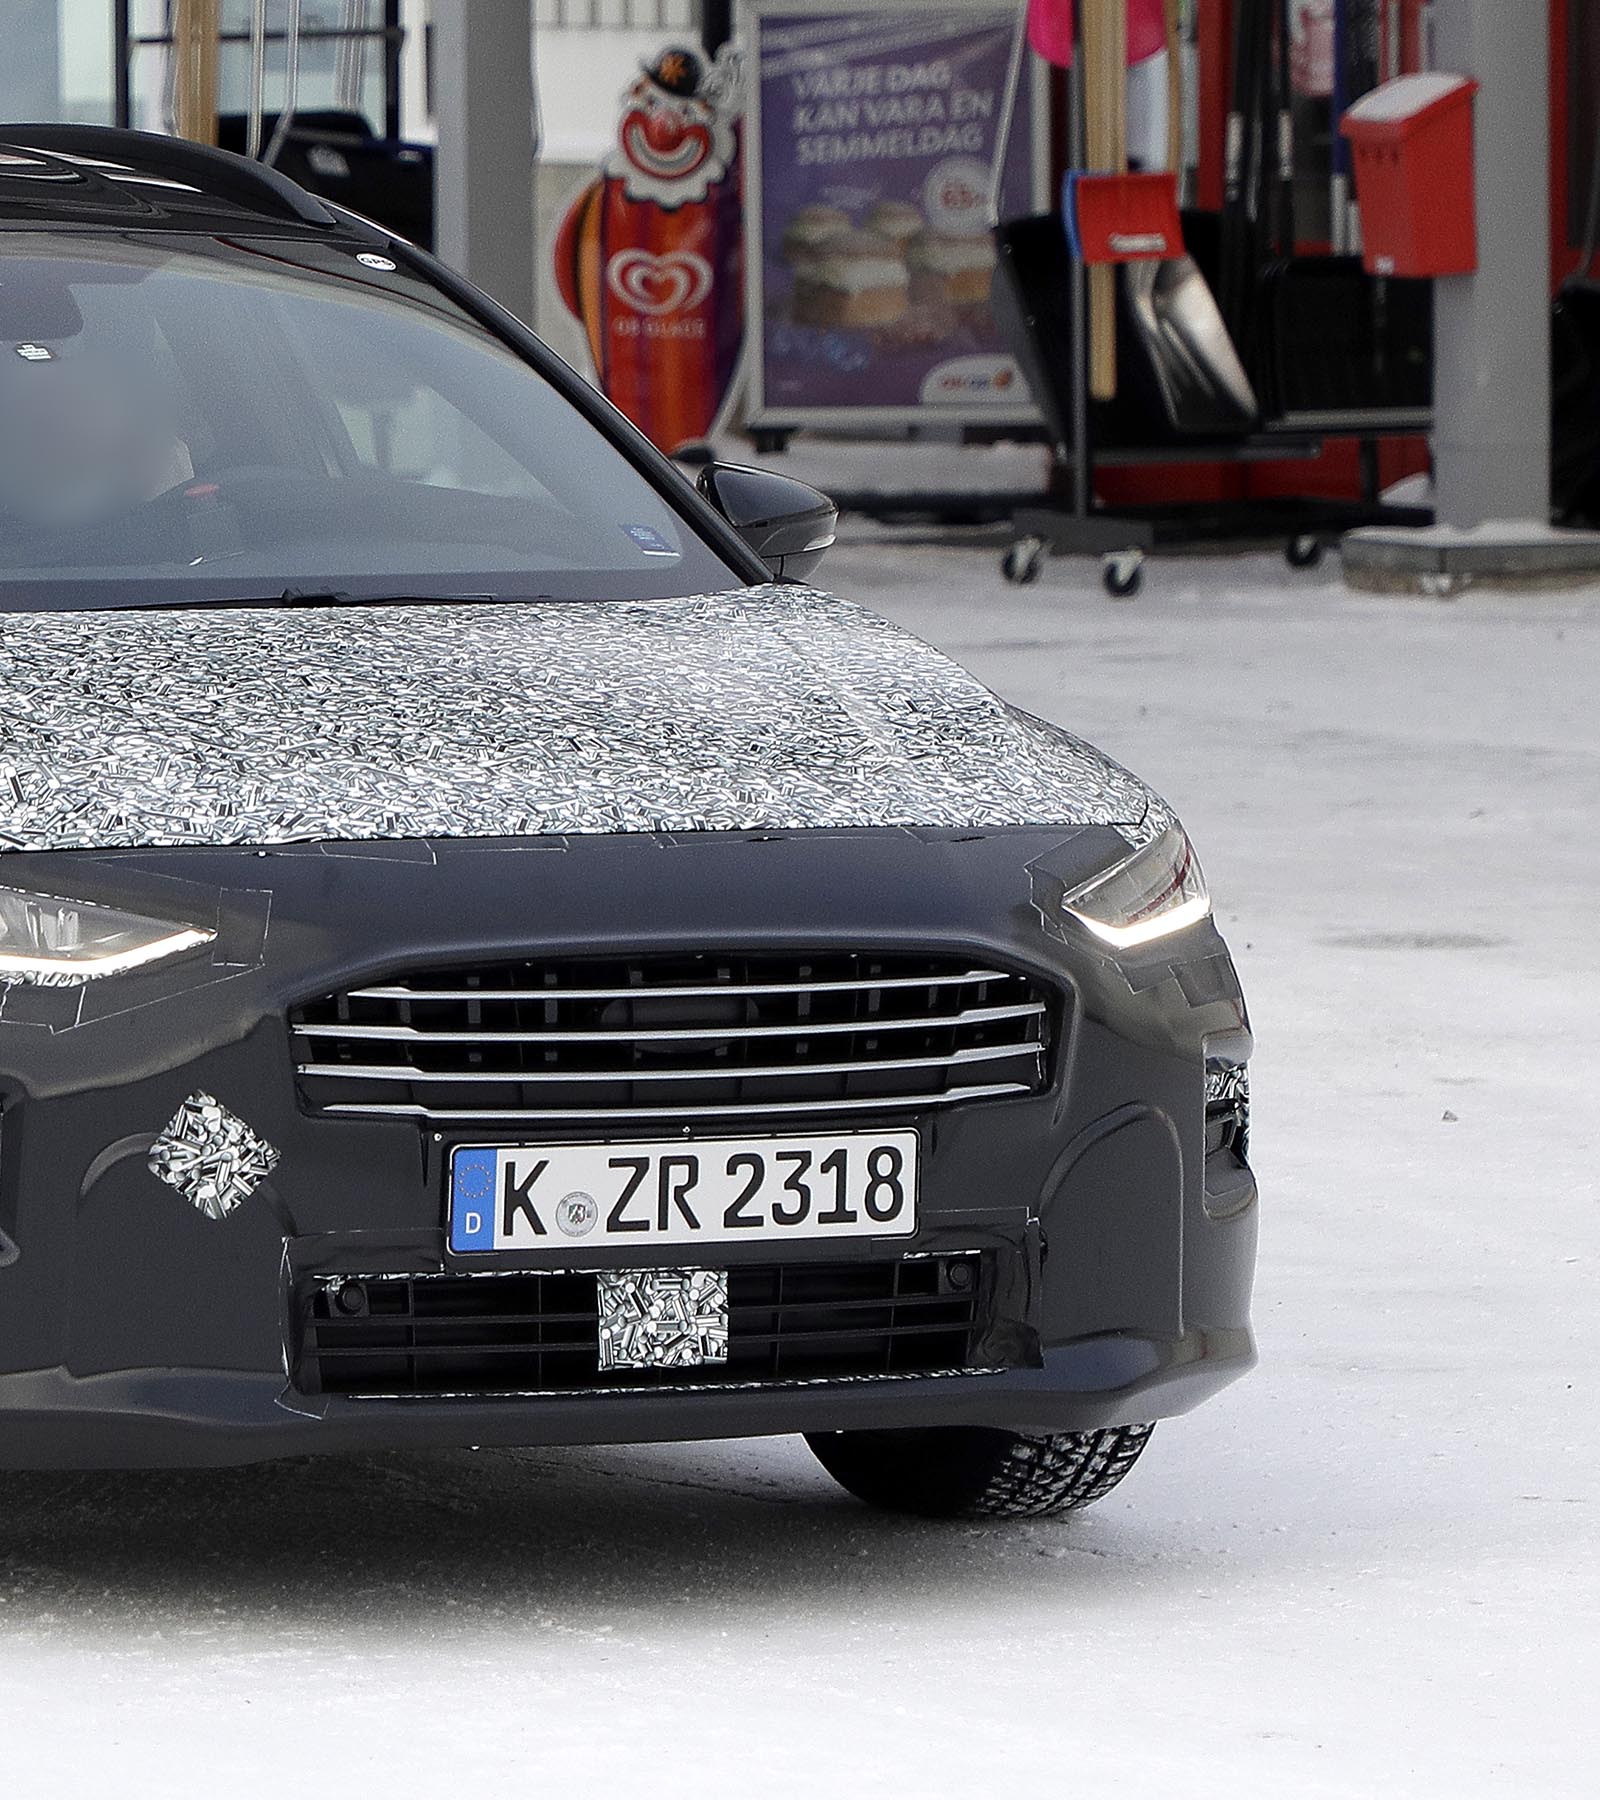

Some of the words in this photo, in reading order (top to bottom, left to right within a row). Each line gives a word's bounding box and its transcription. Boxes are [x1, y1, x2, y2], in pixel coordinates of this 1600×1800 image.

[792, 65, 881, 98] VARJE
[885, 61, 951, 91] DAG
[793, 101, 860, 133] KAN
[864, 94, 946, 126] VARA
[951, 89, 994, 120] EN
[796, 123, 984, 165] SEMMELDAG
[502, 1159, 550, 1236] K
[605, 1154, 701, 1233] ZR
[723, 1146, 903, 1229] 2318
[465, 1212, 481, 1234] D
